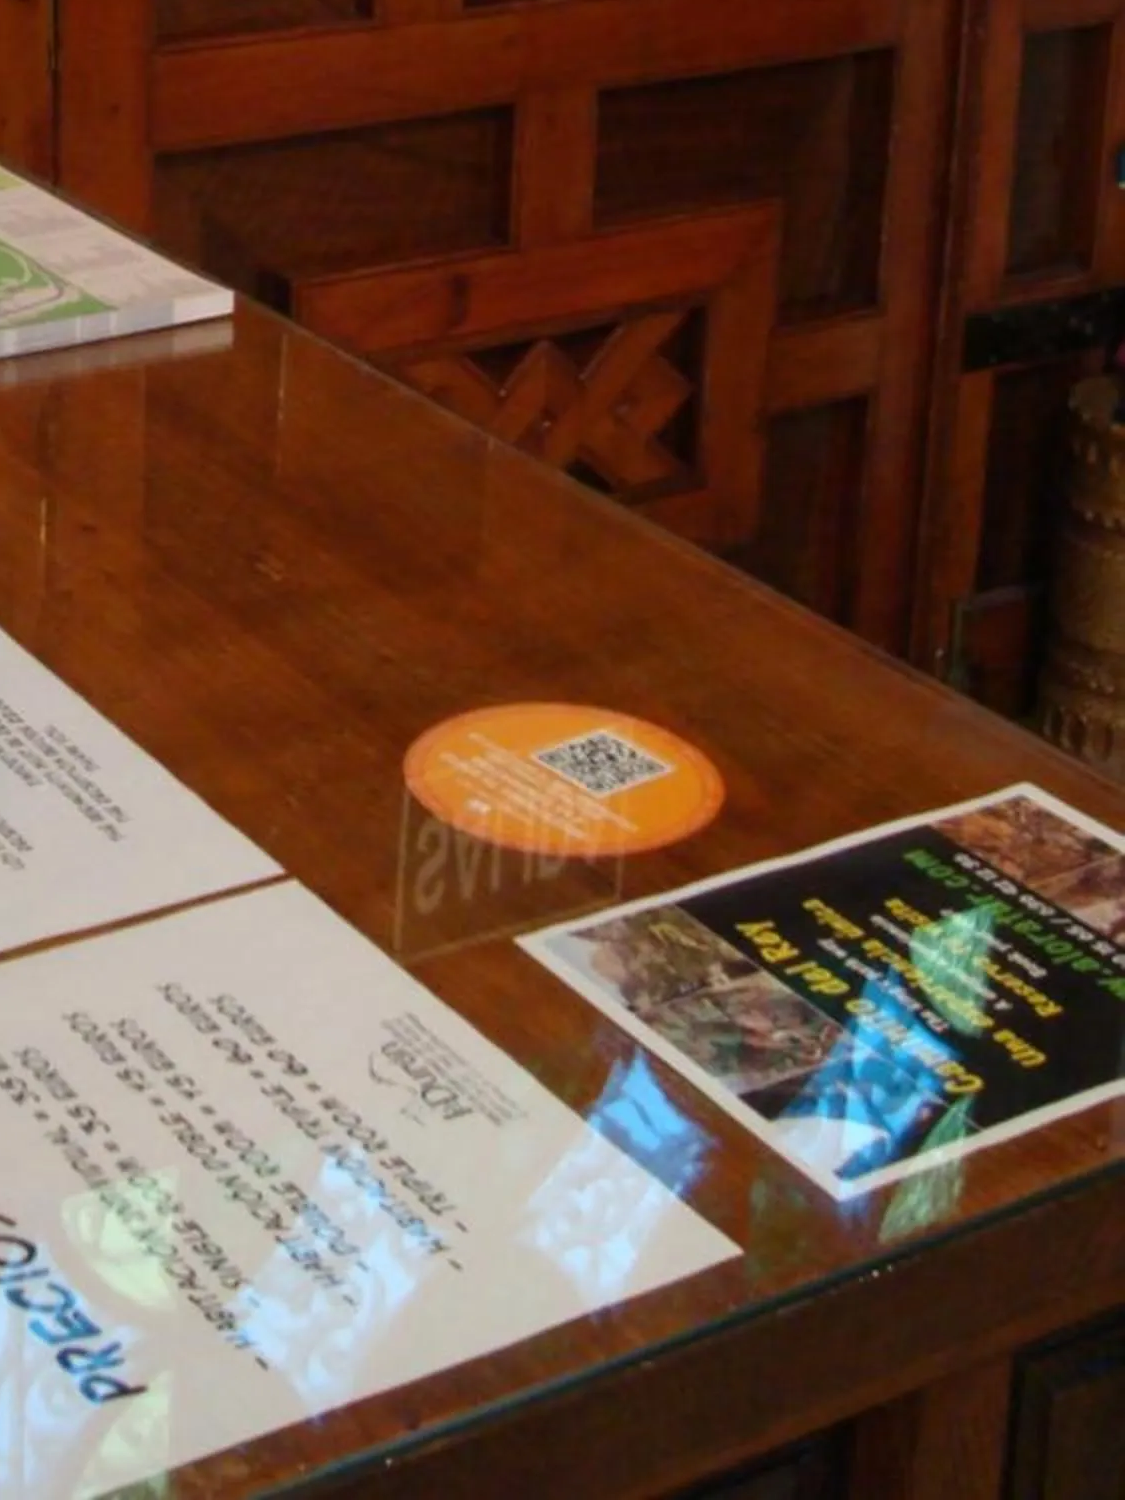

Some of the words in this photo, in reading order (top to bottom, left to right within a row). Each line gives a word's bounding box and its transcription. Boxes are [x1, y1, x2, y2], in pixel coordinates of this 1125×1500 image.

[736, 919, 800, 964] Rey
[802, 898, 864, 940] única
[785, 961, 850, 995] del
[154, 982, 225, 1035] EUROS
[207, 993, 278, 1047] EUROS
[61, 1011, 130, 1066] EUROS
[108, 1017, 180, 1073] EUROS
[845, 998, 984, 1094] Caminito
[993, 1029, 1048, 1068] Una
[13, 1046, 80, 1102] EUROS
[257, 1083, 329, 1141] TRIPLE
[315, 1096, 391, 1153] ROOM
[156, 1111, 233, 1172] DOBLE
[210, 1120, 283, 1178] ROOM
[111, 1155, 187, 1217] ROOM
[314, 1141, 455, 1256] HABITACIÓN
[376, 1155, 458, 1216] TRIPLE
[214, 1174, 345, 1288] HABITACIÓN
[267, 1180, 362, 1257] DOUBLE
[169, 1218, 251, 1291] SINGLE
[132, 1227, 257, 1351] HABITACIÓN
